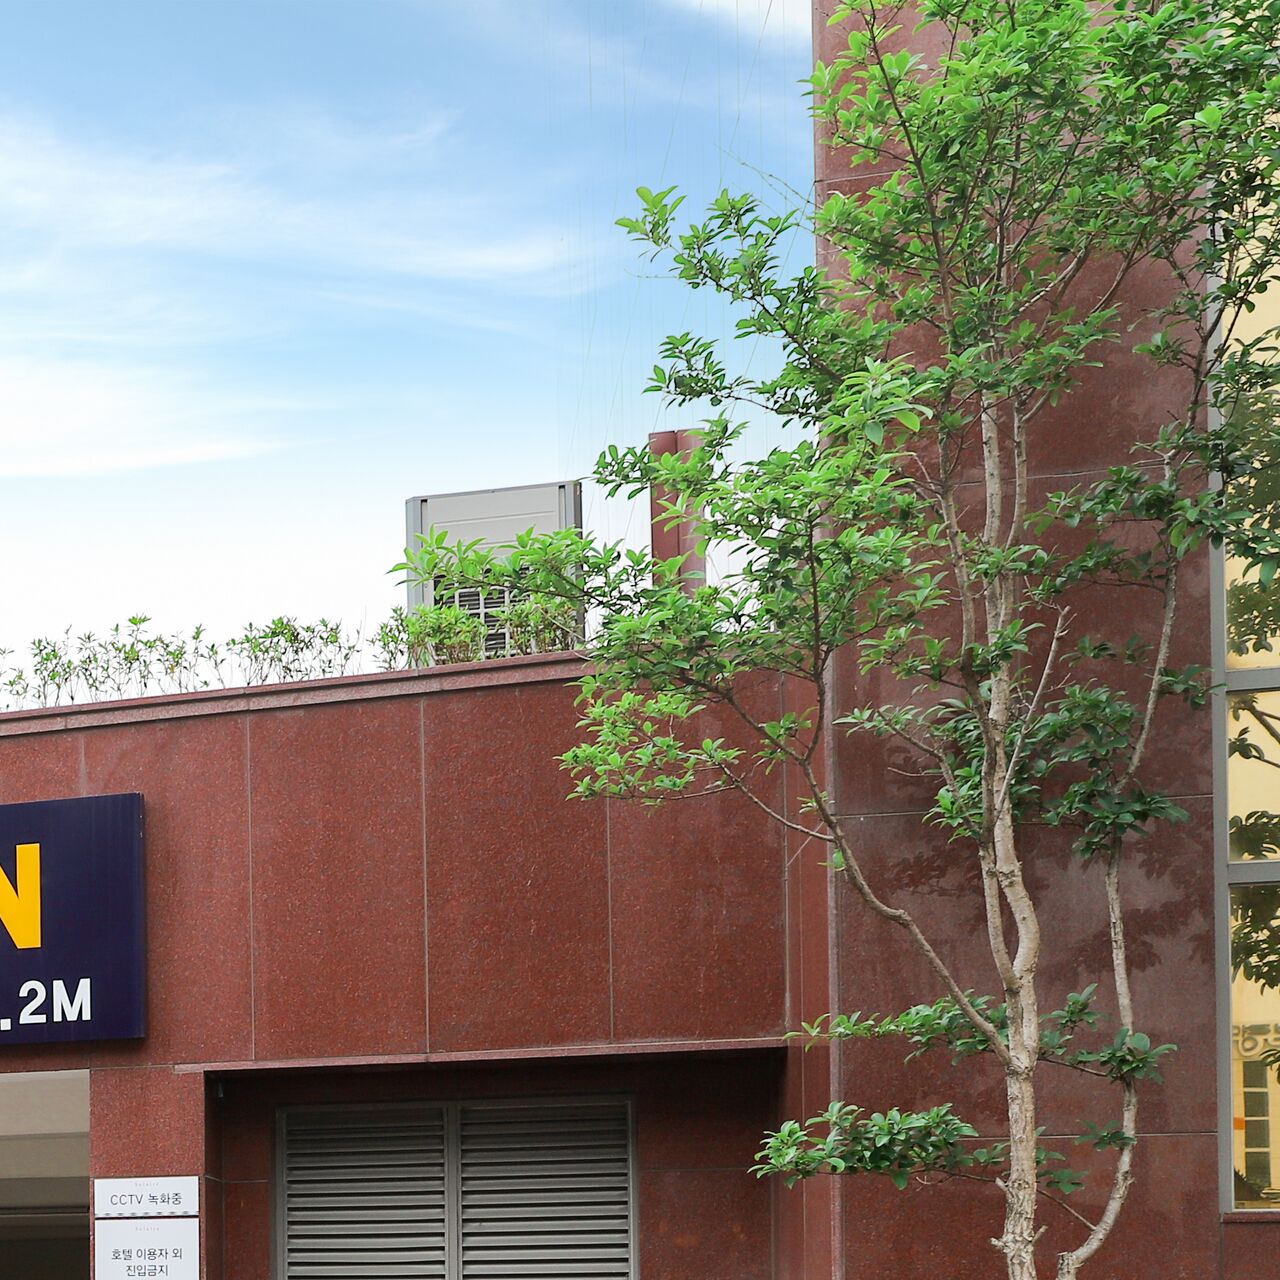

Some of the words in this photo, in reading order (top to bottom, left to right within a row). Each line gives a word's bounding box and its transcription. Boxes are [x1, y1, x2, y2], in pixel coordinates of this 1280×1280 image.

[110, 1194, 144, 1206] CCTV
[148, 1192, 183, 1206] 녹화중
[111, 1248, 133, 1261] 호텔
[136, 1248, 169, 1260] 이용자
[172, 1247, 183, 1260] 외
[125, 1264, 169, 1277] 진입금지
